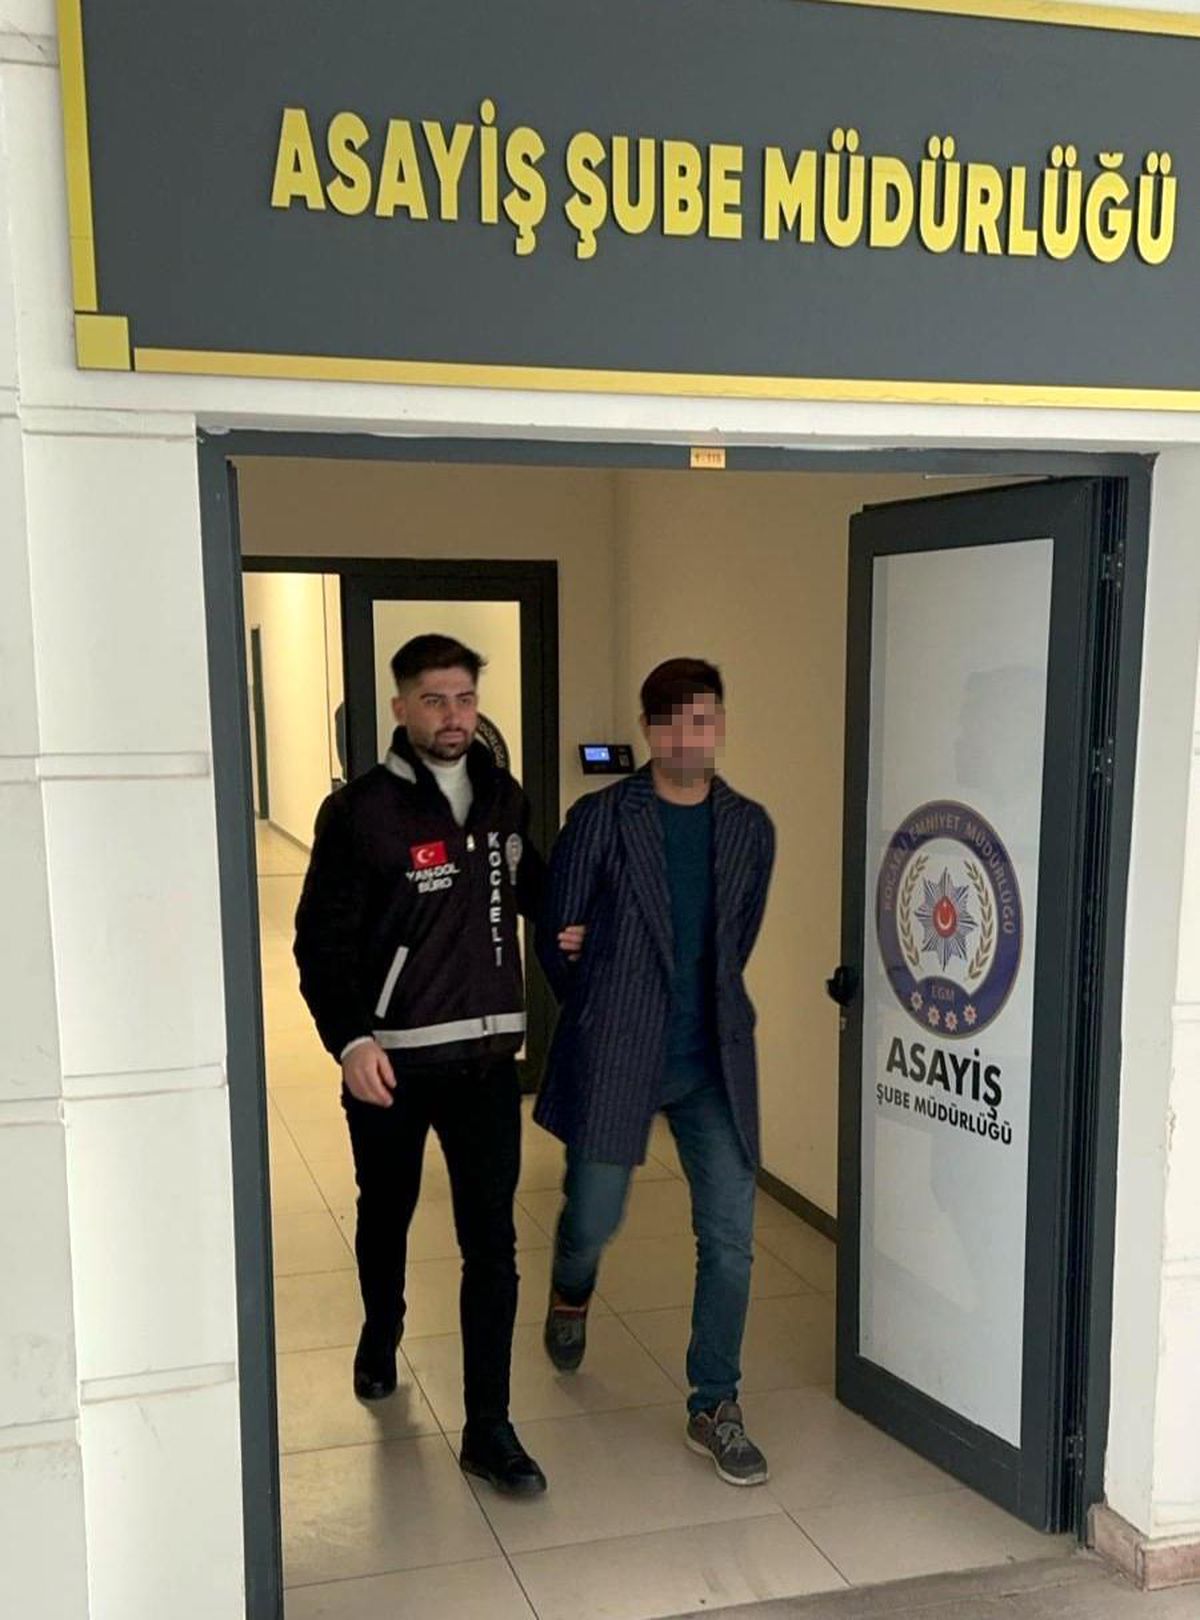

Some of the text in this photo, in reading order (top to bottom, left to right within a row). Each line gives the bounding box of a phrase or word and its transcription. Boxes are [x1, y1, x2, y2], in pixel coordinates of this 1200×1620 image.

[271, 99, 1178, 265] ASAYİŞ ŞUBE MÜDÜRLÜĞÜ
[876, 1082, 1012, 1145] ŞUBE MÜDÜRLÜĞÜ
[886, 1036, 1002, 1121] ASAYİŞ
